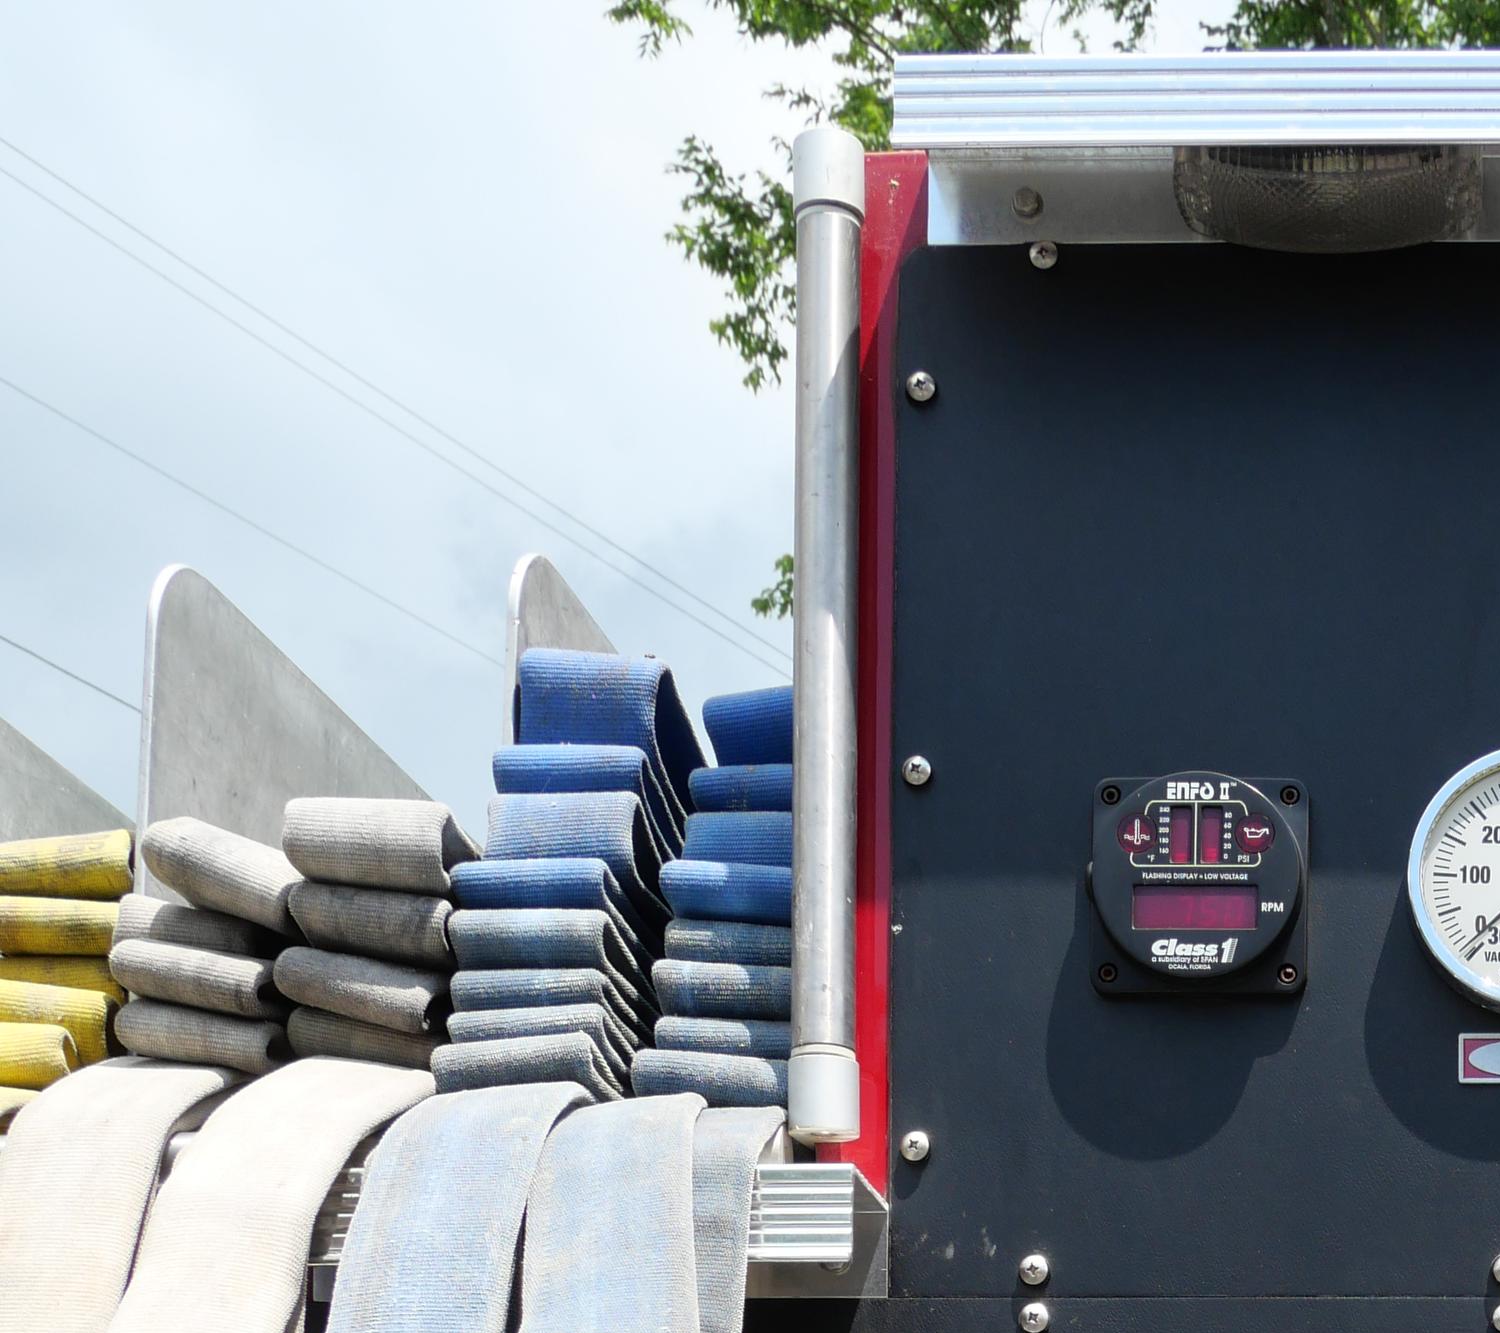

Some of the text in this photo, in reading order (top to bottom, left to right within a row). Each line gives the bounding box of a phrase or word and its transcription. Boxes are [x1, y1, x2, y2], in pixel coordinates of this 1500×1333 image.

[1173, 872, 1198, 880] DISPLAY
[1220, 873, 1248, 881] VOLTAGE
[1459, 865, 1491, 884] 100
[1261, 902, 1284, 913] RPM
